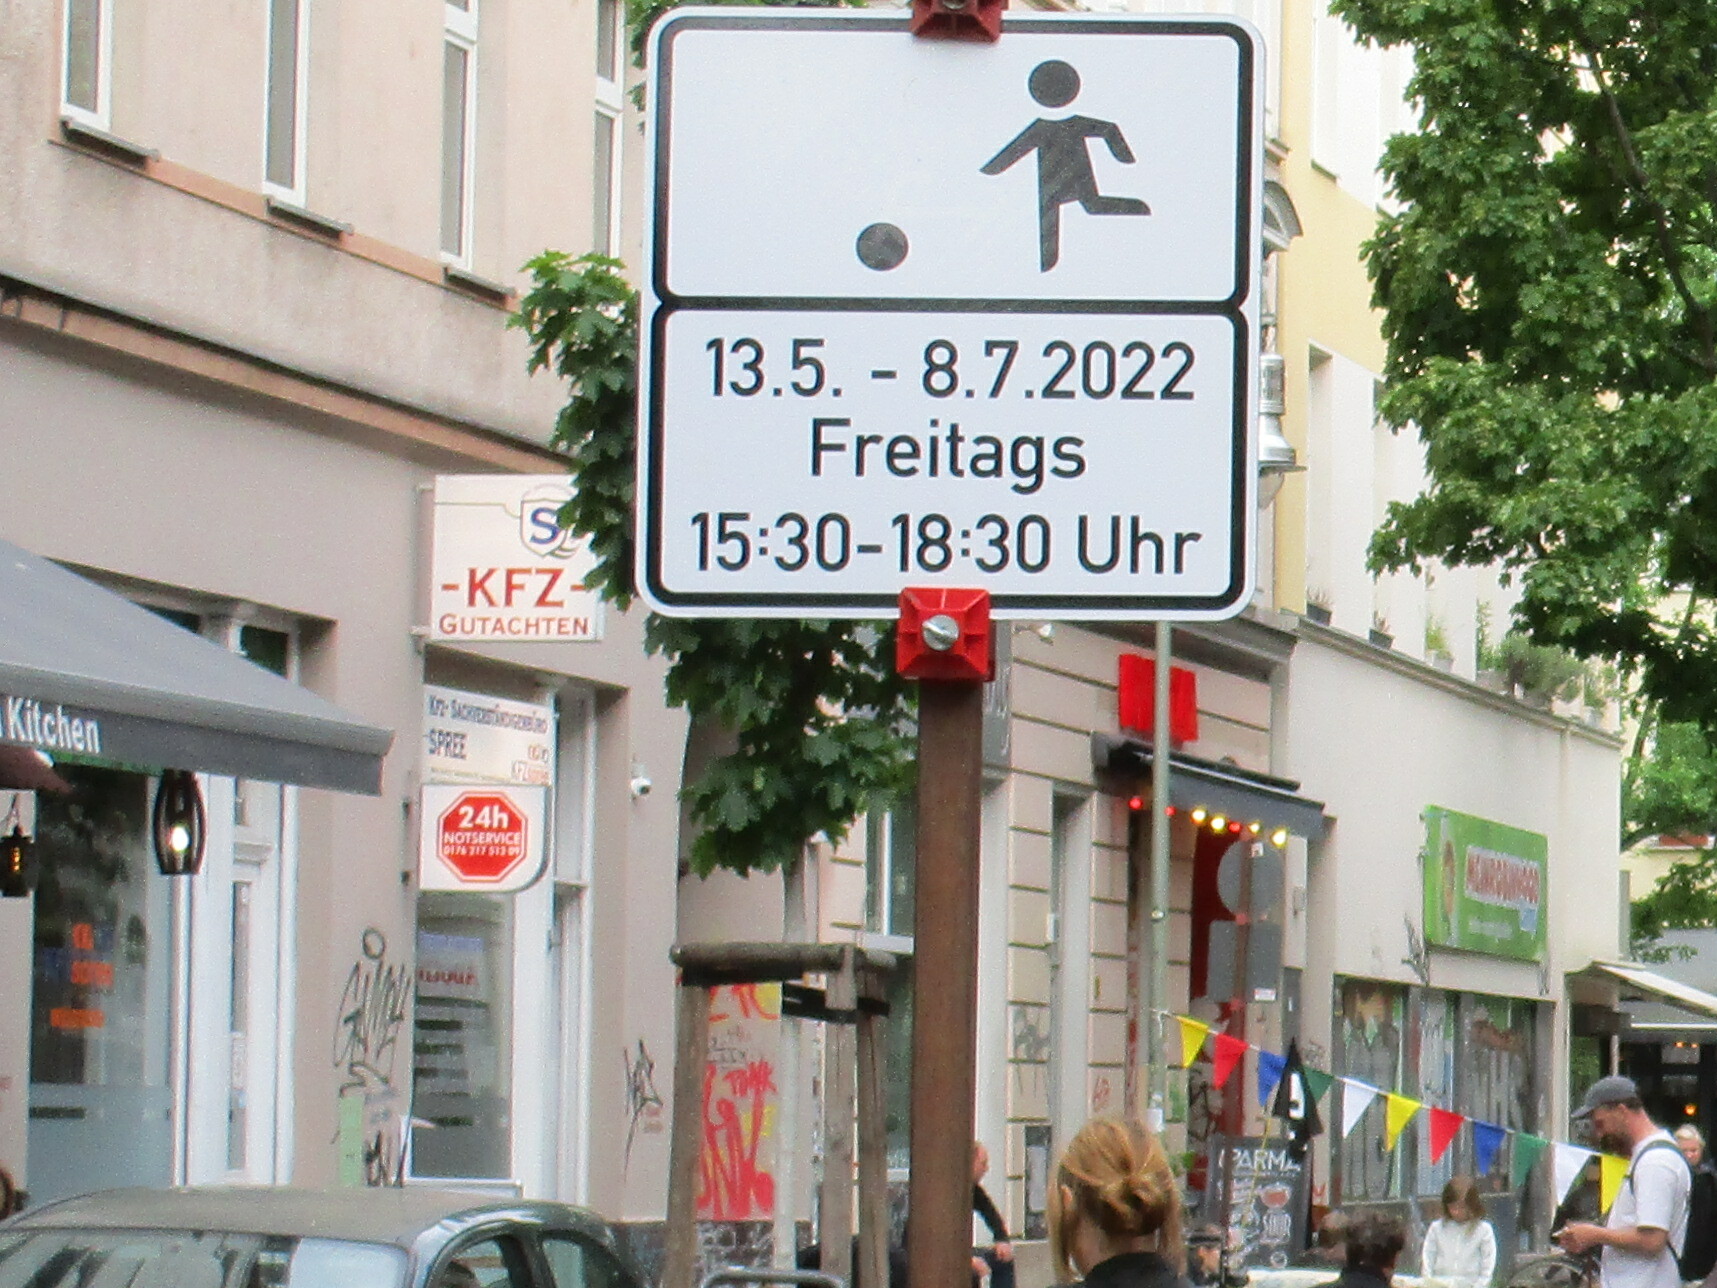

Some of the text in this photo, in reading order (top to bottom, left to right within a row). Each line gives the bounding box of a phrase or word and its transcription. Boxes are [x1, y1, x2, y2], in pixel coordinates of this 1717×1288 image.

[705, 337, 842, 398] 13.5.
[921, 339, 1195, 401] 8.7.2022
[811, 417, 1086, 494] Freitags
[691, 512, 1202, 574] 15:30-18:30 Uhr
[439, 614, 588, 635] GUTACHTEN
[7, 696, 101, 754] Kitchen
[444, 832, 520, 844] NOTSERVICE
[458, 805, 509, 829] 24h
